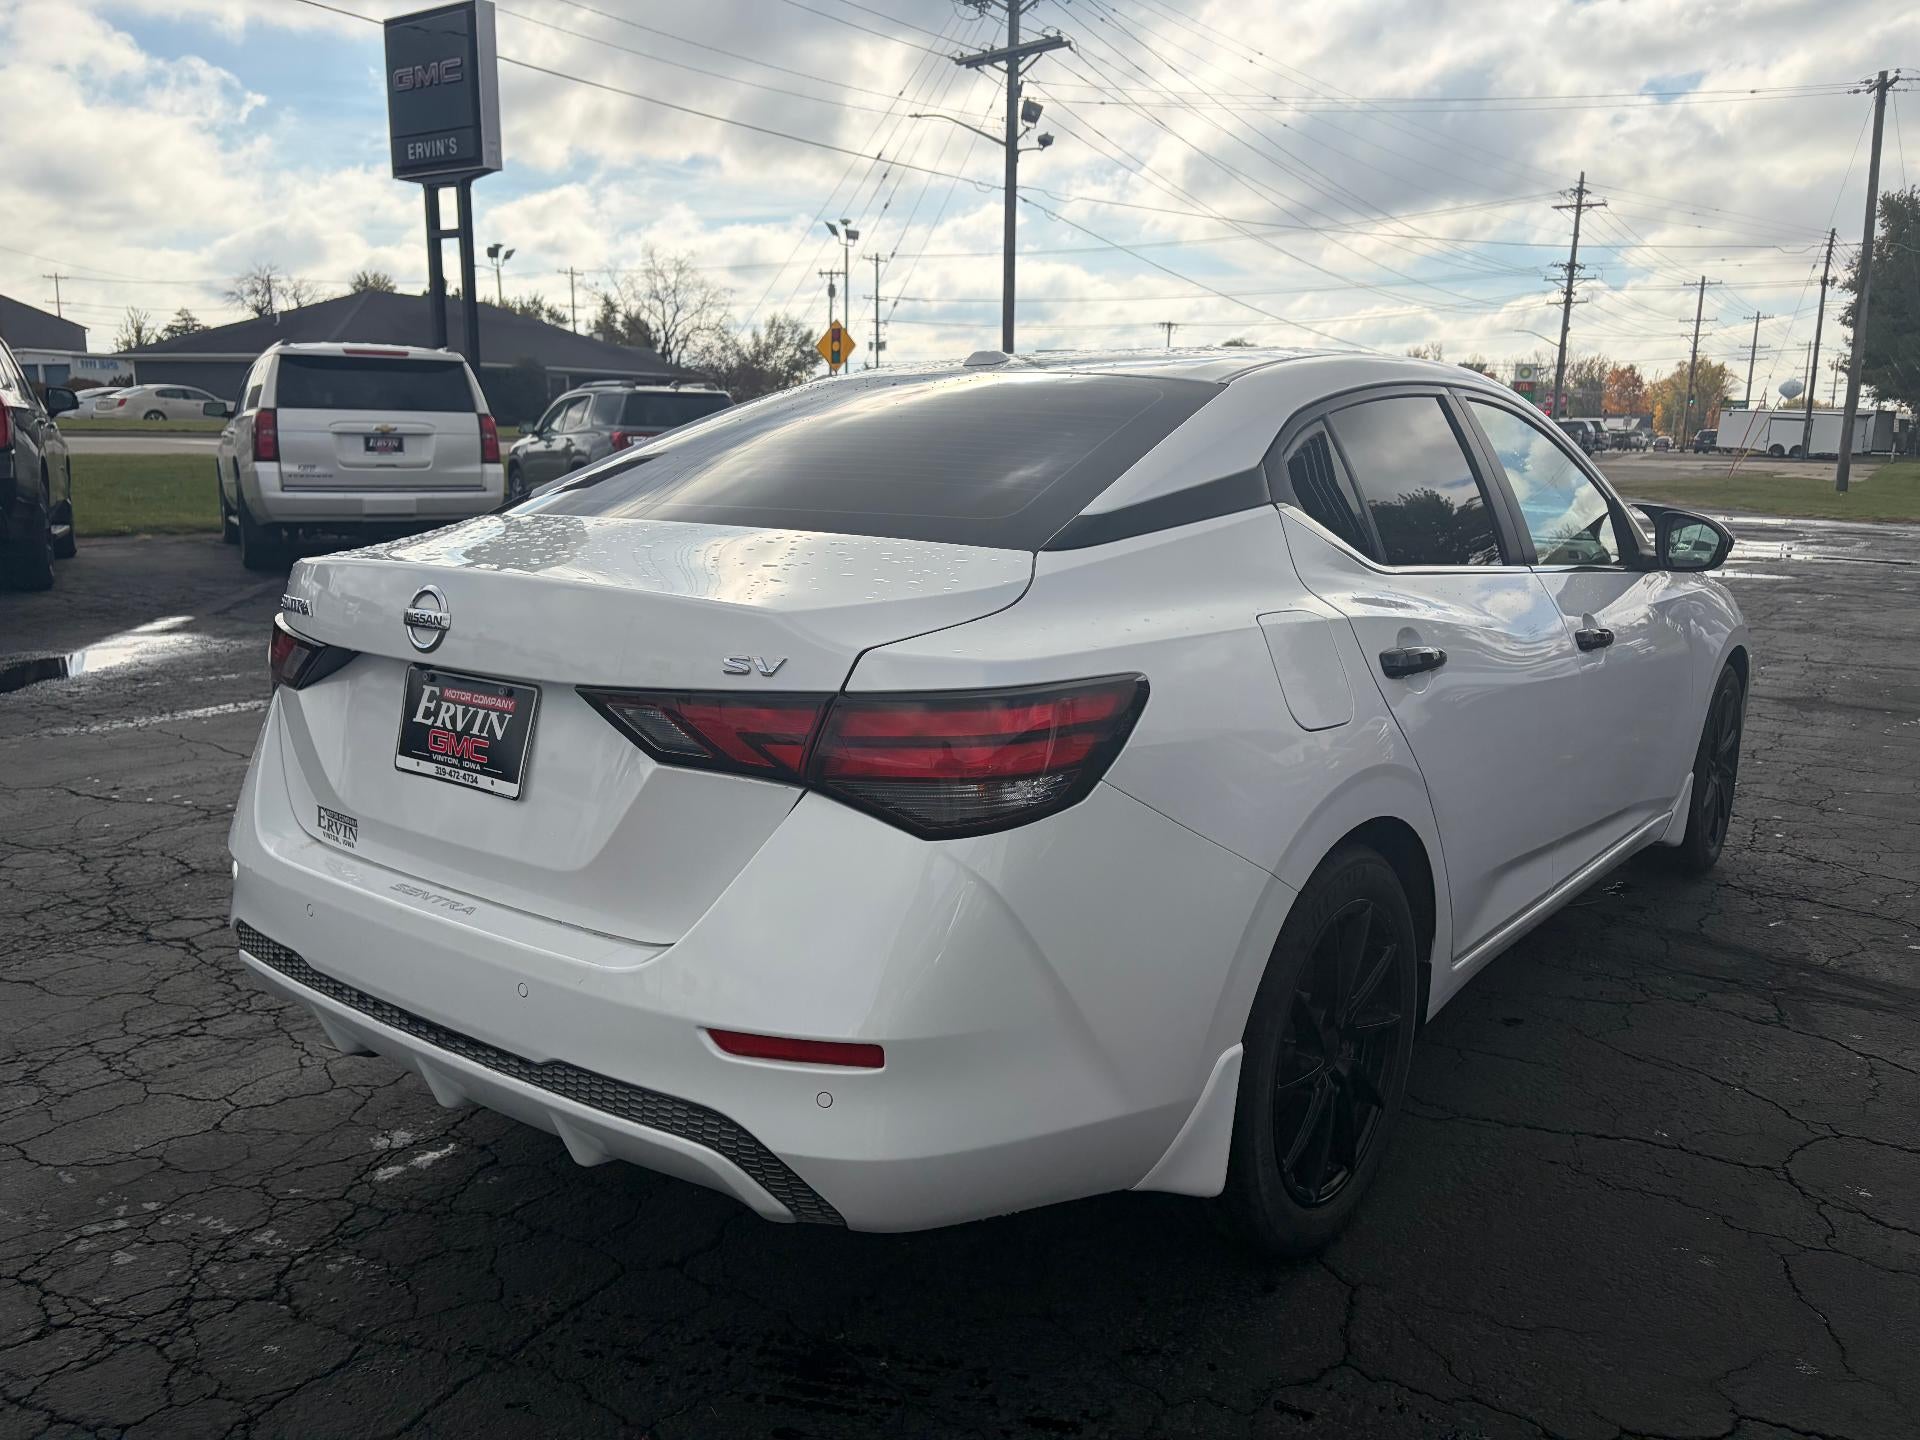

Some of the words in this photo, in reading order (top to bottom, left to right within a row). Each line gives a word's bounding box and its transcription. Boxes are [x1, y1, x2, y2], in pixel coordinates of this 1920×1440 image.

[392, 57, 462, 90] GMC
[407, 137, 458, 160] ERVIN'S
[405, 611, 443, 627] NISSAN
[722, 655, 788, 677] SV
[444, 688, 472, 702] MOTOR
[472, 694, 515, 710] COMPANY
[412, 684, 513, 741] ERVIN
[428, 728, 490, 764] GMC
[431, 753, 461, 768] VINTON,
[462, 760, 481, 771] IOWA
[434, 765, 479, 785] 319-472-4734
[317, 804, 358, 842] ERVIN
[389, 883, 477, 916] SENTRA
